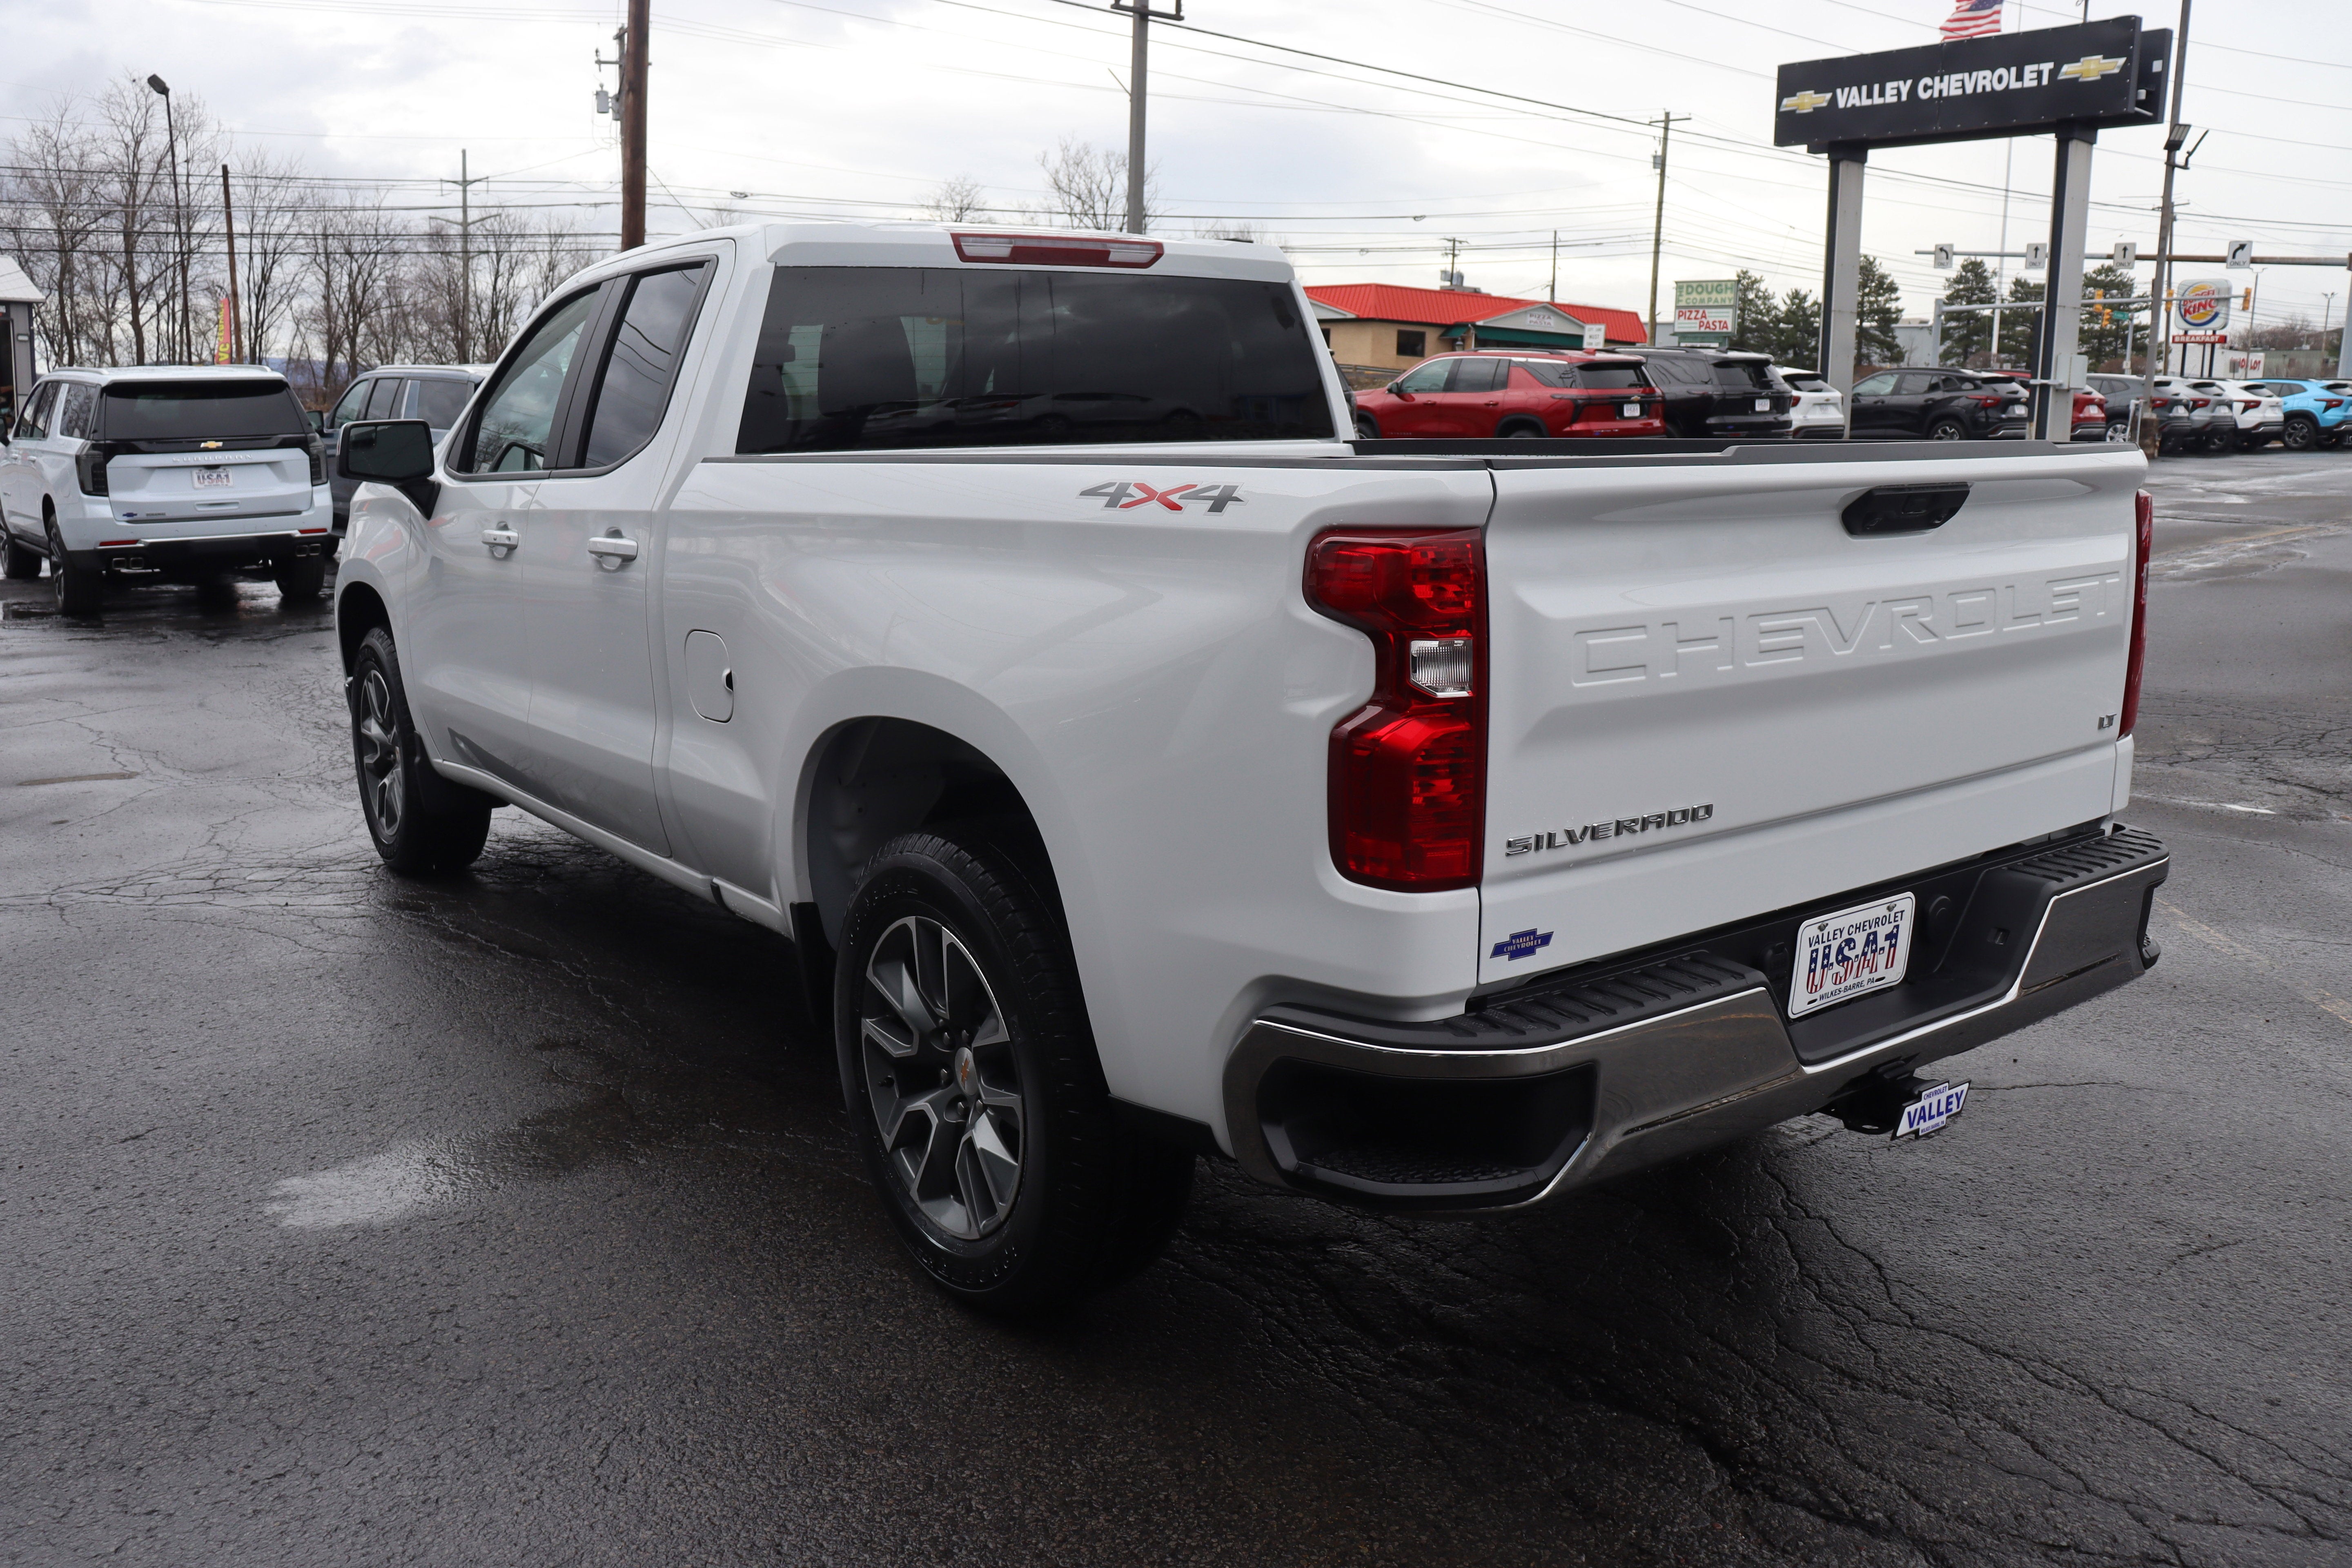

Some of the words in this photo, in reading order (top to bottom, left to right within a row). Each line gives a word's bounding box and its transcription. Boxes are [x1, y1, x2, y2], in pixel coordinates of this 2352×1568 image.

[1836, 79, 1913, 109] VALLEY
[1918, 62, 2054, 100] CHEVROLET
[1686, 283, 1733, 295] DOUGH
[1678, 310, 1707, 320] PIZZA
[1699, 320, 1728, 330] PASTA
[1572, 571, 2120, 688] CHEVROLET
[2098, 713, 2117, 730] LT
[1505, 802, 1713, 856] SILVERADO
[1809, 927, 1845, 948] VALLEY
[1847, 910, 1905, 936] CHEVROLET
[1503, 938, 1541, 952] CHEVROLET
[1512, 935, 1534, 944] VALLEY
[1819, 980, 1865, 1001] WILKES-BARRE,
[1866, 977, 1875, 985] PA
[1924, 1085, 1948, 1100] CHEVROLET
[1907, 1089, 1964, 1129] VALLEY
[1921, 1125, 1931, 1134] WILKES
